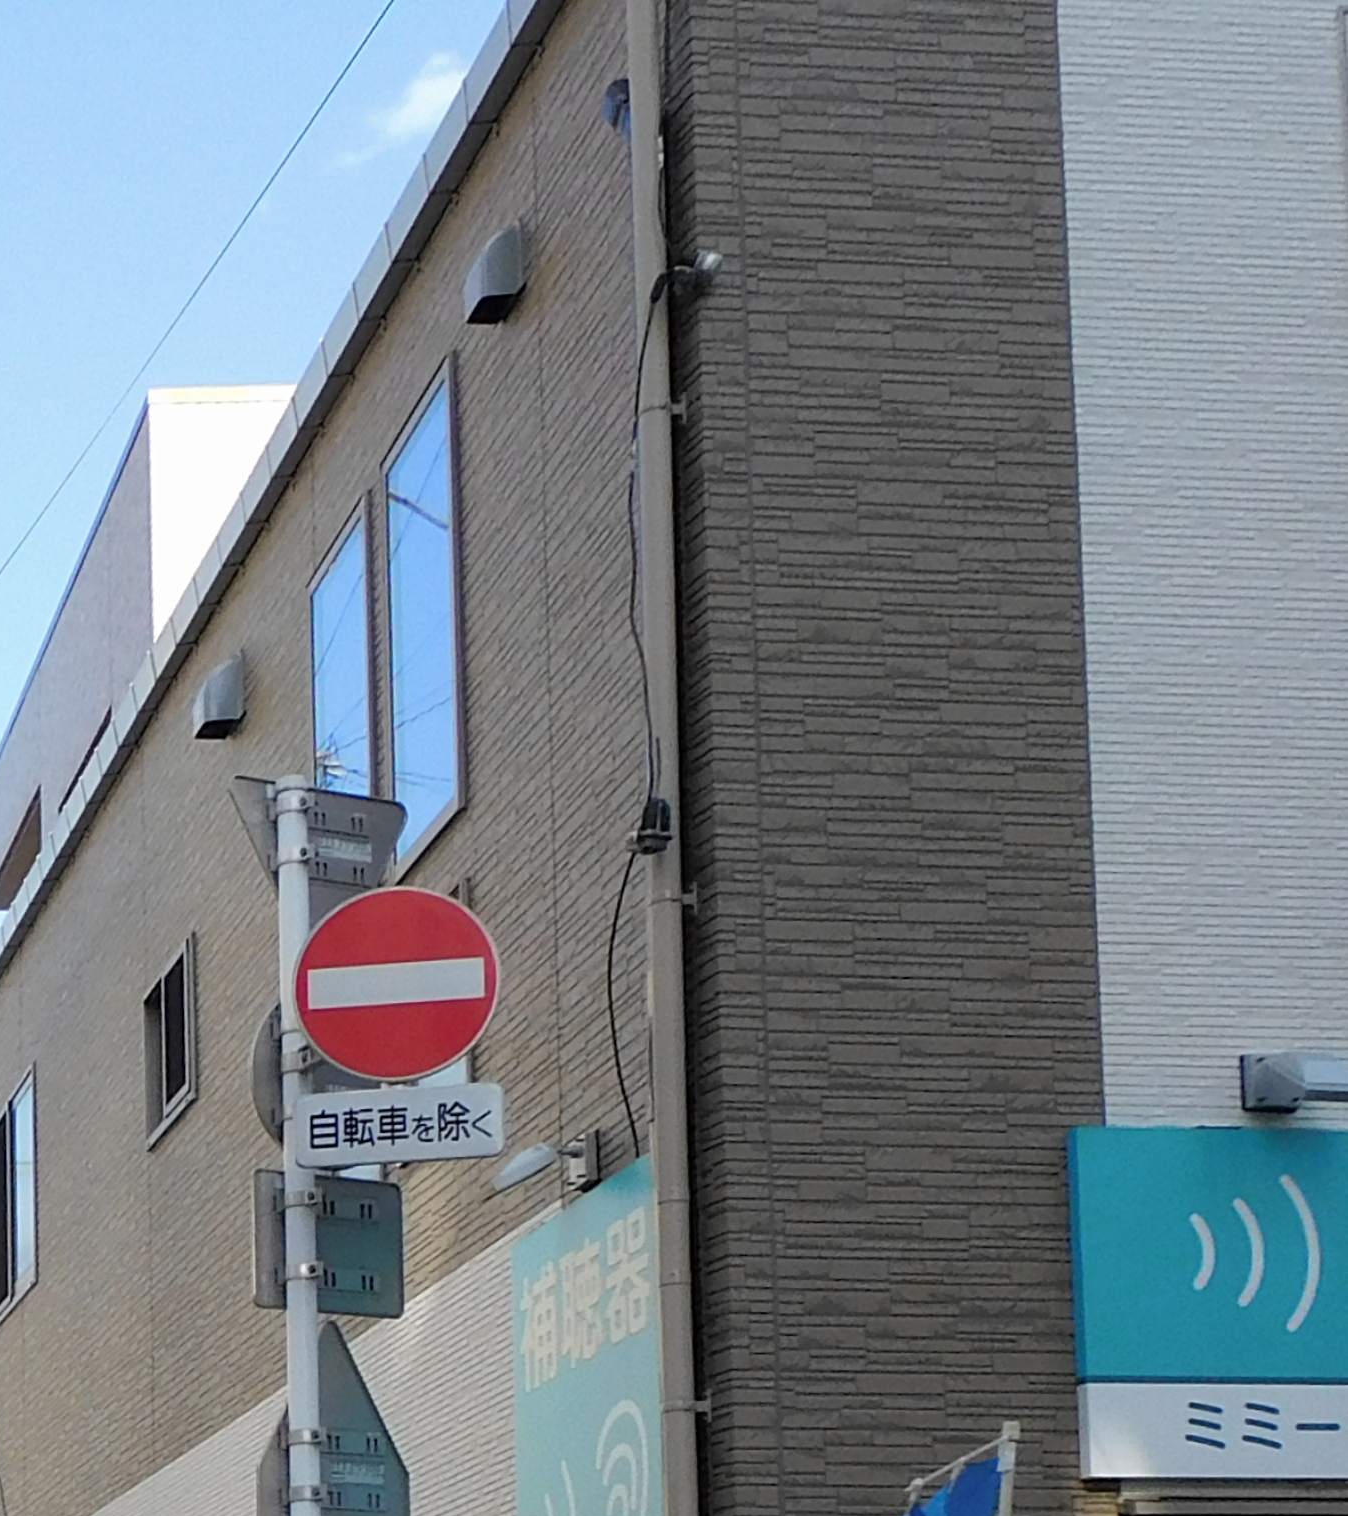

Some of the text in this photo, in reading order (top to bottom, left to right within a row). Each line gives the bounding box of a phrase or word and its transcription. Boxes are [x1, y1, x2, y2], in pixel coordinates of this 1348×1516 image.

[308, 1101, 494, 1152] 自転車を除く
[518, 1207, 654, 1393] 補聴器
[1185, 1401, 1342, 1449] ミミー
